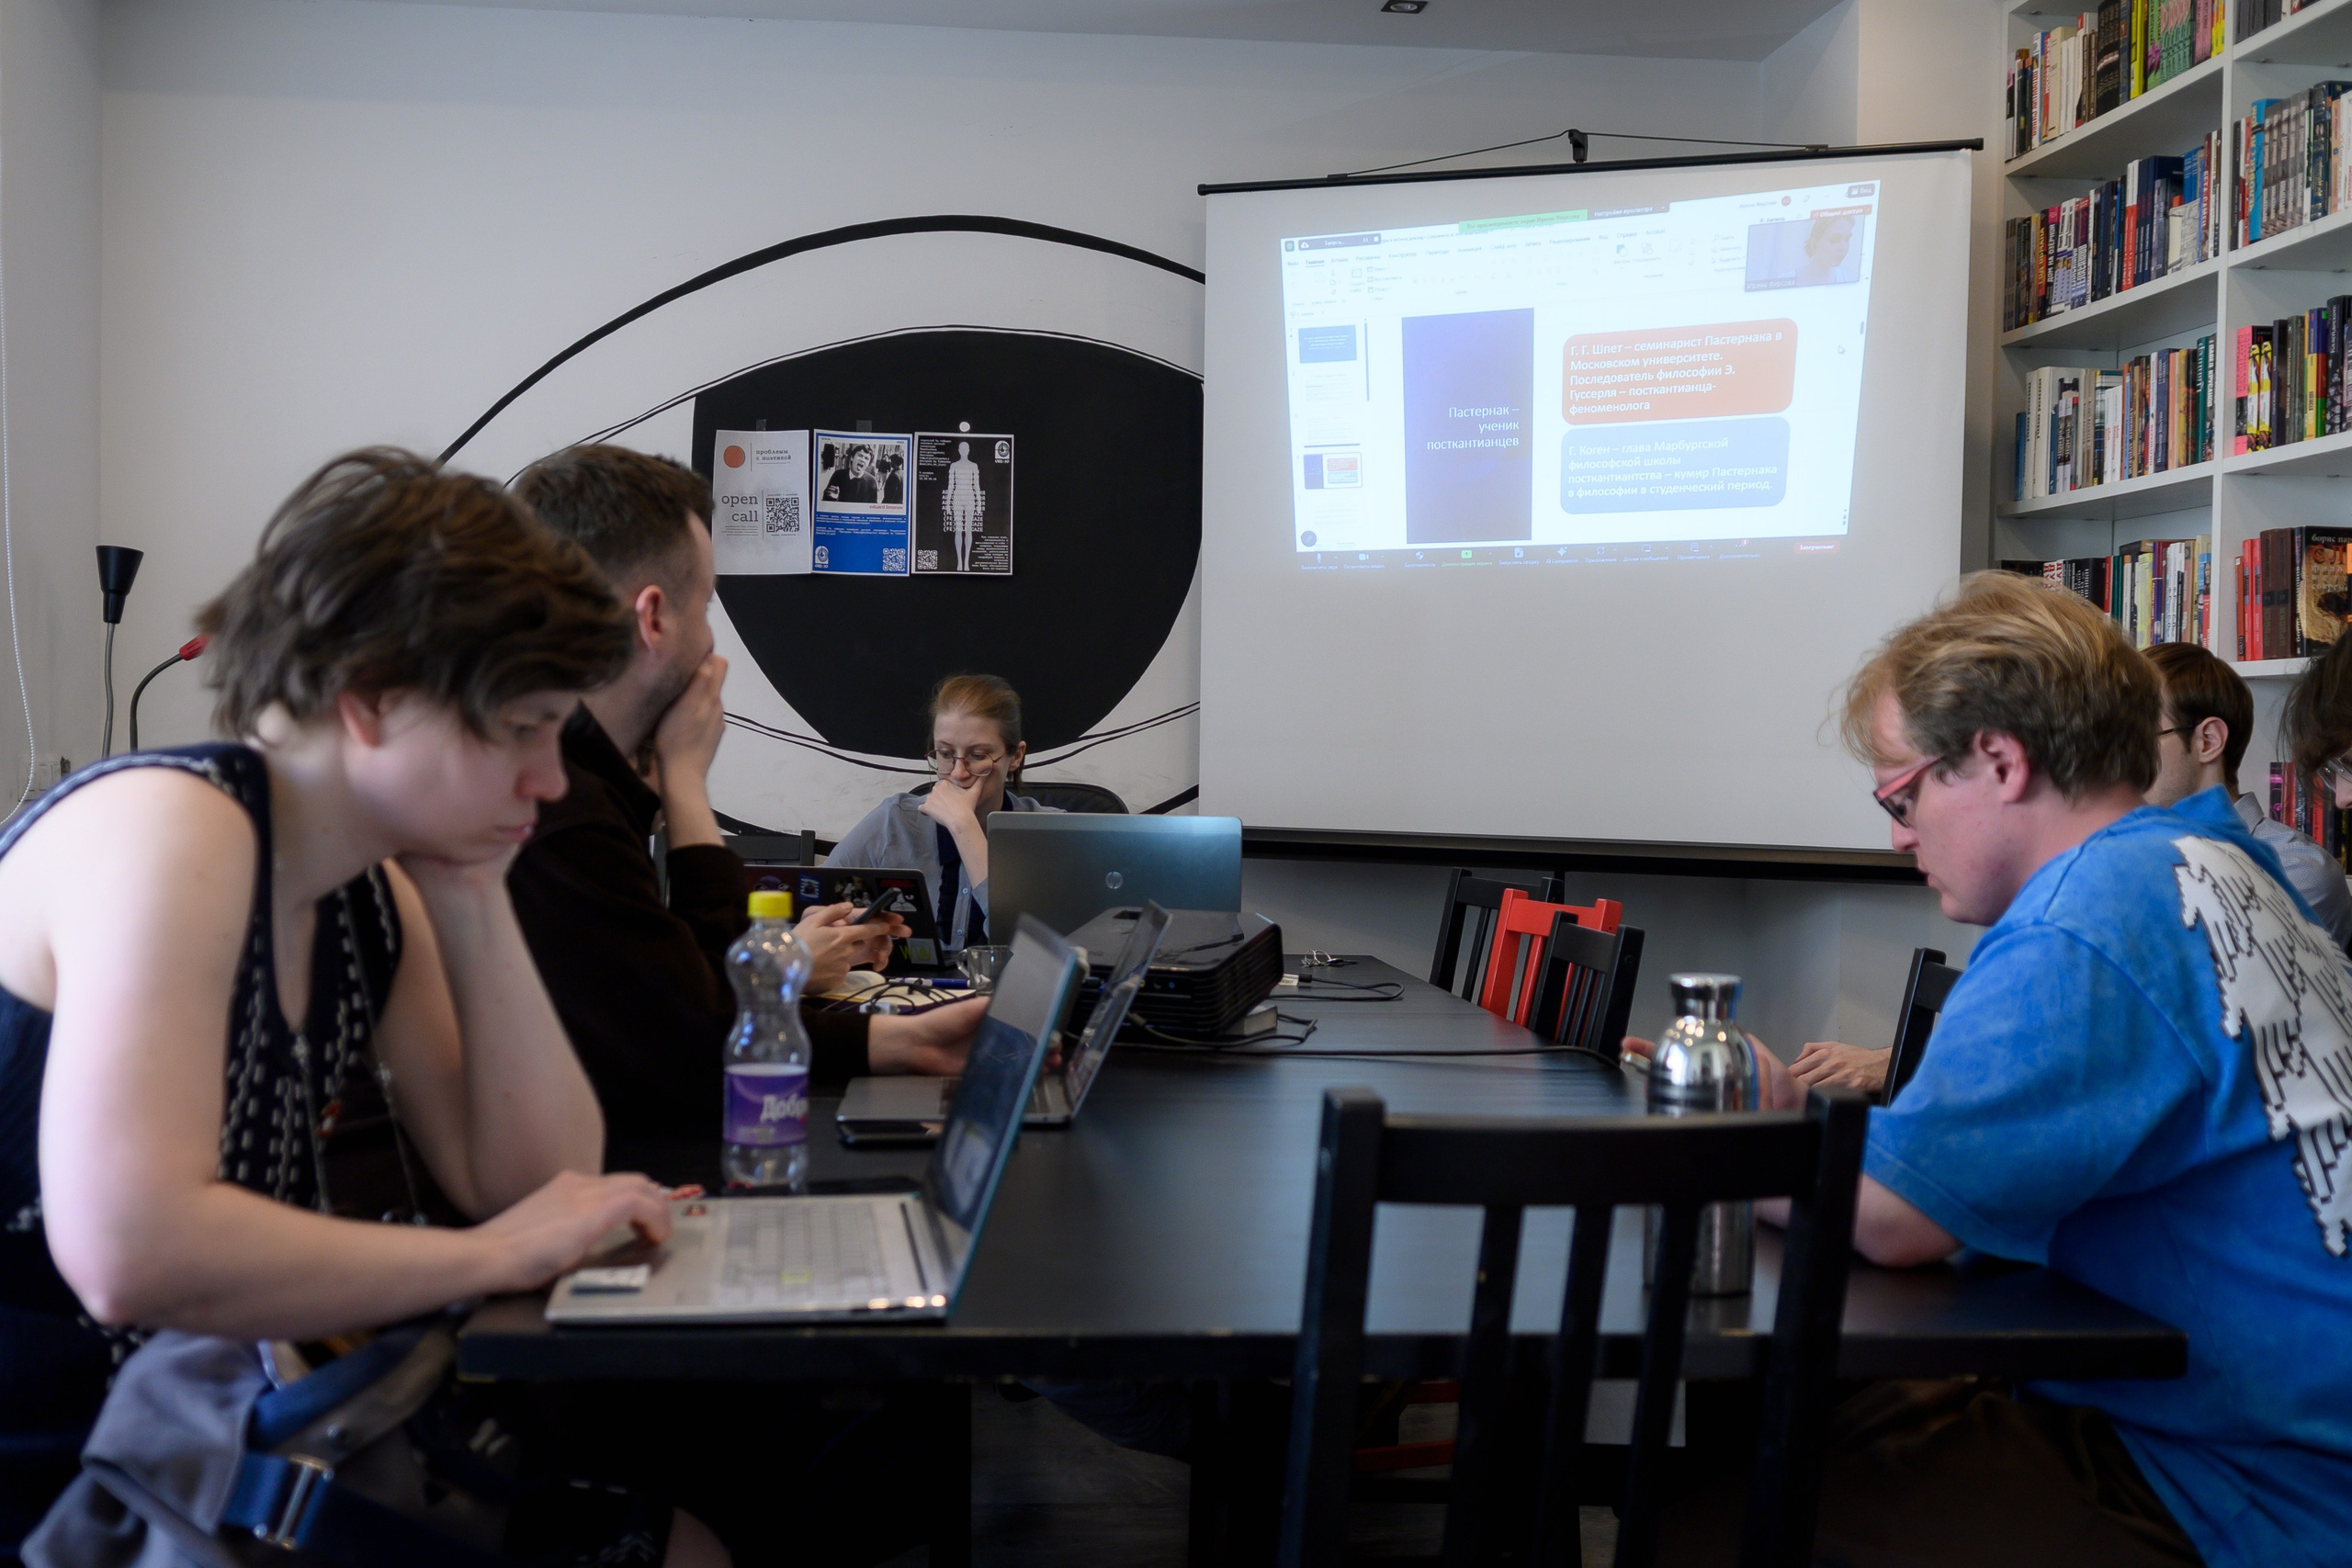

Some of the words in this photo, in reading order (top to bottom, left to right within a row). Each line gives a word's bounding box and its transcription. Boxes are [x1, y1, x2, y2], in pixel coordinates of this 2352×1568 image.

[1571, 345, 1578, 355] Г.
[1582, 344, 1589, 355] Г.
[1593, 344, 1622, 355] Шпет
[1634, 339, 1702, 352] семинарист
[1705, 333, 1771, 345] Пастернака
[1776, 332, 1781, 341] в
[1571, 358, 1639, 370] Московском
[1643, 351, 1723, 367] университете.
[1570, 371, 1654, 386] Последователь
[1657, 365, 1722, 380] философии
[1724, 365, 1736, 375] Э.
[1570, 389, 1616, 401] Гуссерля
[1629, 382, 1716, 397] посткантианца-
[1449, 406, 1509, 418] Пастернак
[1569, 401, 1649, 415] феноменолога
[1479, 422, 1519, 434] ученик
[1428, 437, 1519, 450] посткантианцев
[1569, 446, 1577, 456] Г.
[1579, 445, 1610, 455] Коген
[1623, 444, 1651, 453] глава
[1655, 437, 1728, 451] Марбургской
[1568, 458, 1641, 471] философской
[1644, 457, 1681, 466] школы
[1568, 471, 1662, 483] посткантиантства
[1674, 468, 1709, 479] кумир
[1713, 466, 1777, 478] Пастернака
[1577, 486, 1637, 499] философии
[1641, 485, 1646, 494] в
[1649, 480, 1724, 495] студенческий
[1727, 479, 1772, 491] период.
[721, 495, 758, 507] open
[732, 511, 759, 522] call
[2312, 534, 2336, 544] борис
